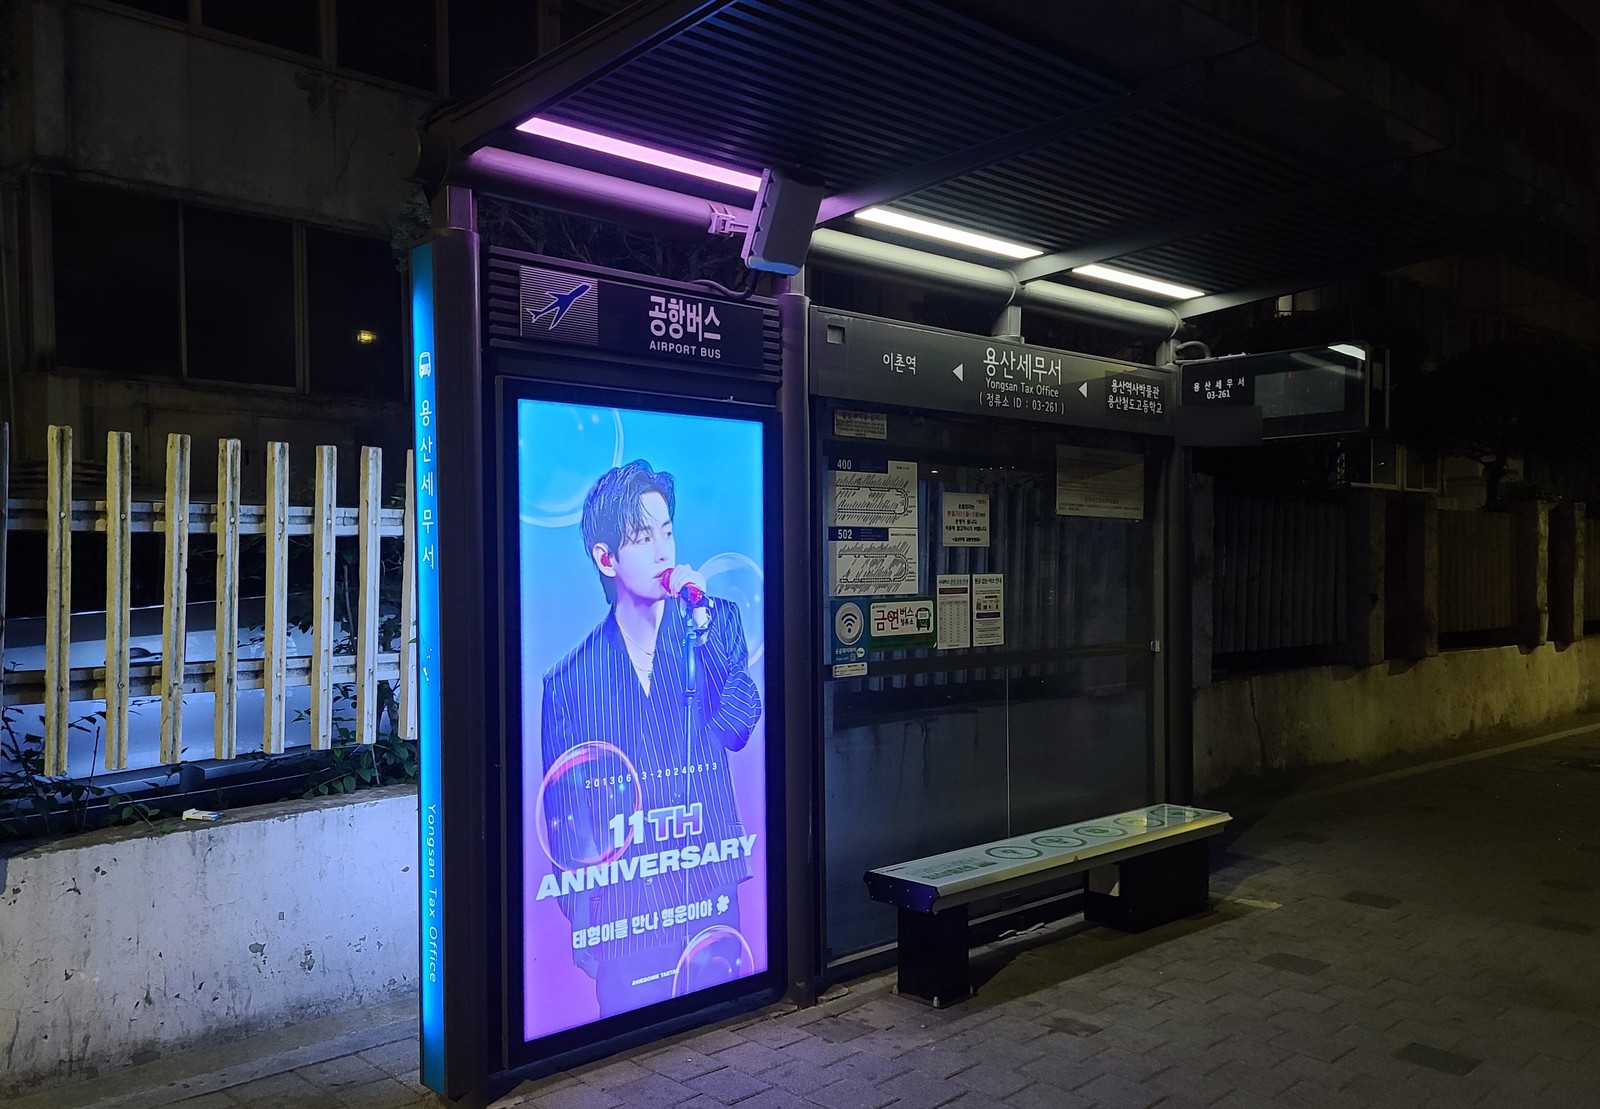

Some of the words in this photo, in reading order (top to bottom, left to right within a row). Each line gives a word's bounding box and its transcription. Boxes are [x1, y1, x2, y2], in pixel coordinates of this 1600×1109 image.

[649, 295, 721, 342] 공항버스
[649, 340, 697, 356] AIRPORT
[700, 347, 721, 359] BUS
[882, 352, 916, 375] 이촌역
[983, 347, 1062, 385] 용산세무서
[985, 376, 1018, 393] Yongsan
[1020, 383, 1034, 395] Tax
[1036, 384, 1059, 398] Office
[1110, 378, 1160, 400] 용산역사박물관
[1206, 389, 1231, 400] 03-261
[1013, 399, 1022, 409] ID
[836, 459, 852, 470] 400
[418, 399, 435, 570] 용산세무서
[837, 528, 853, 540] 502
[874, 607, 900, 631] 금연
[900, 606, 914, 618] 버스
[609, 802, 703, 849] 11TH
[427, 803, 437, 880] Yongsan
[536, 834, 758, 901] ANNIVERSARY
[428, 887, 438, 918] Tax
[572, 918, 629, 949] 태형이를
[631, 911, 659, 936] 만나
[661, 898, 713, 928] 행운이야
[429, 925, 439, 984] Office
